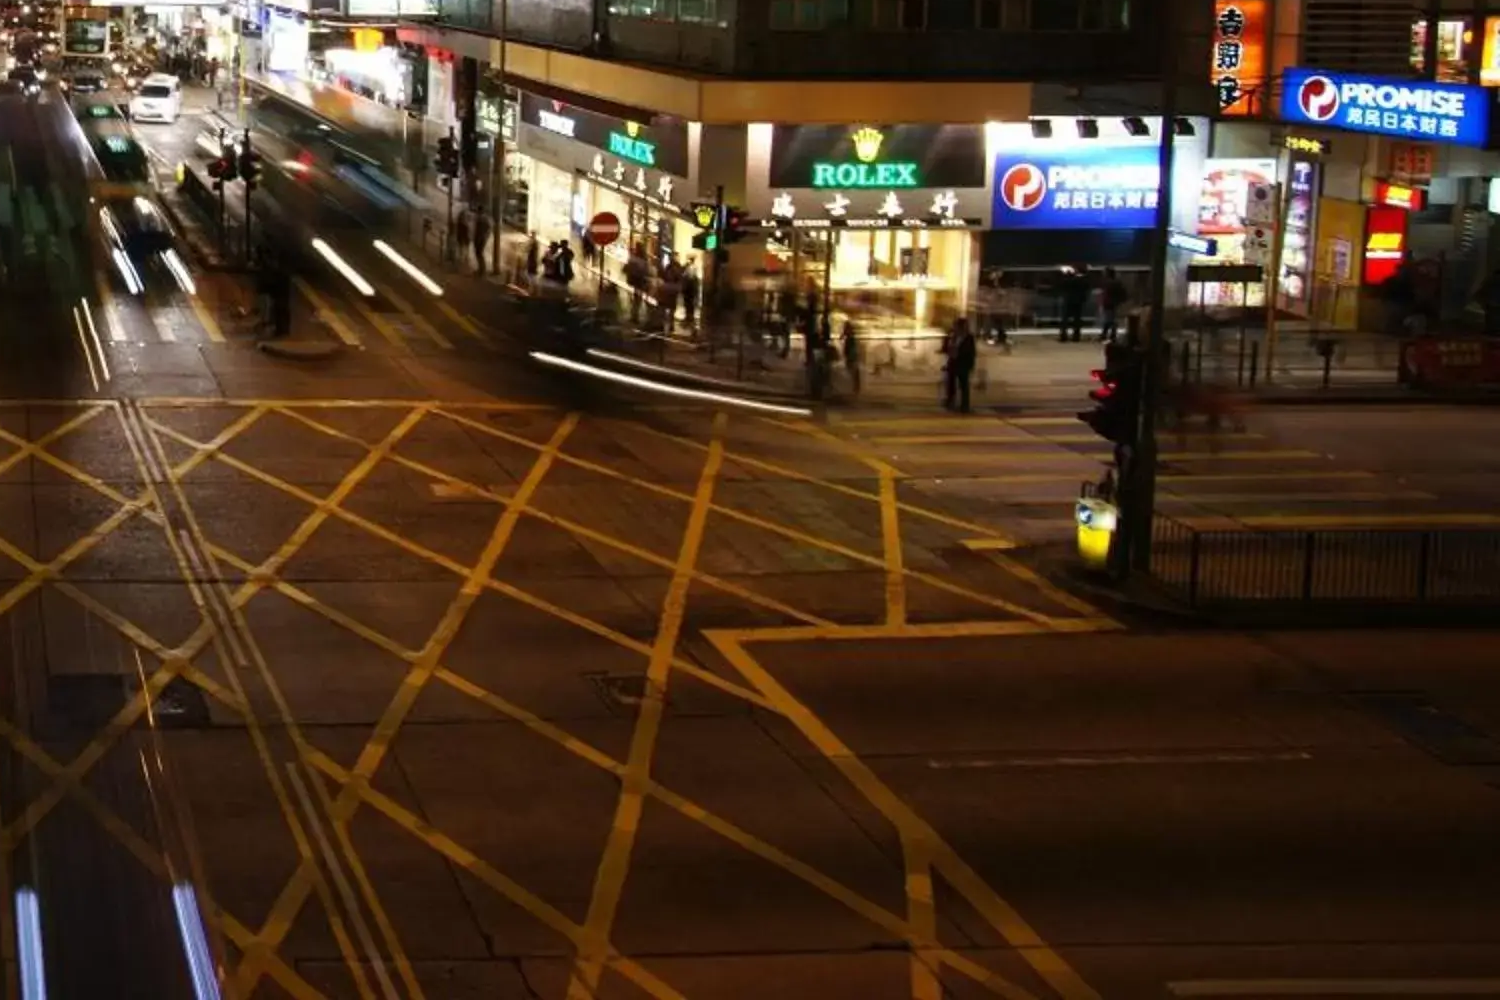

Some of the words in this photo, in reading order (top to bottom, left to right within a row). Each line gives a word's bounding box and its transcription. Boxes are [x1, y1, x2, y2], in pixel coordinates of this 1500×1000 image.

[1341, 83, 1465, 118] PROMISE
[1347, 108, 1458, 137] 邦民日本財務
[610, 132, 656, 165] ROLEX
[813, 163, 917, 186] ROLEX
